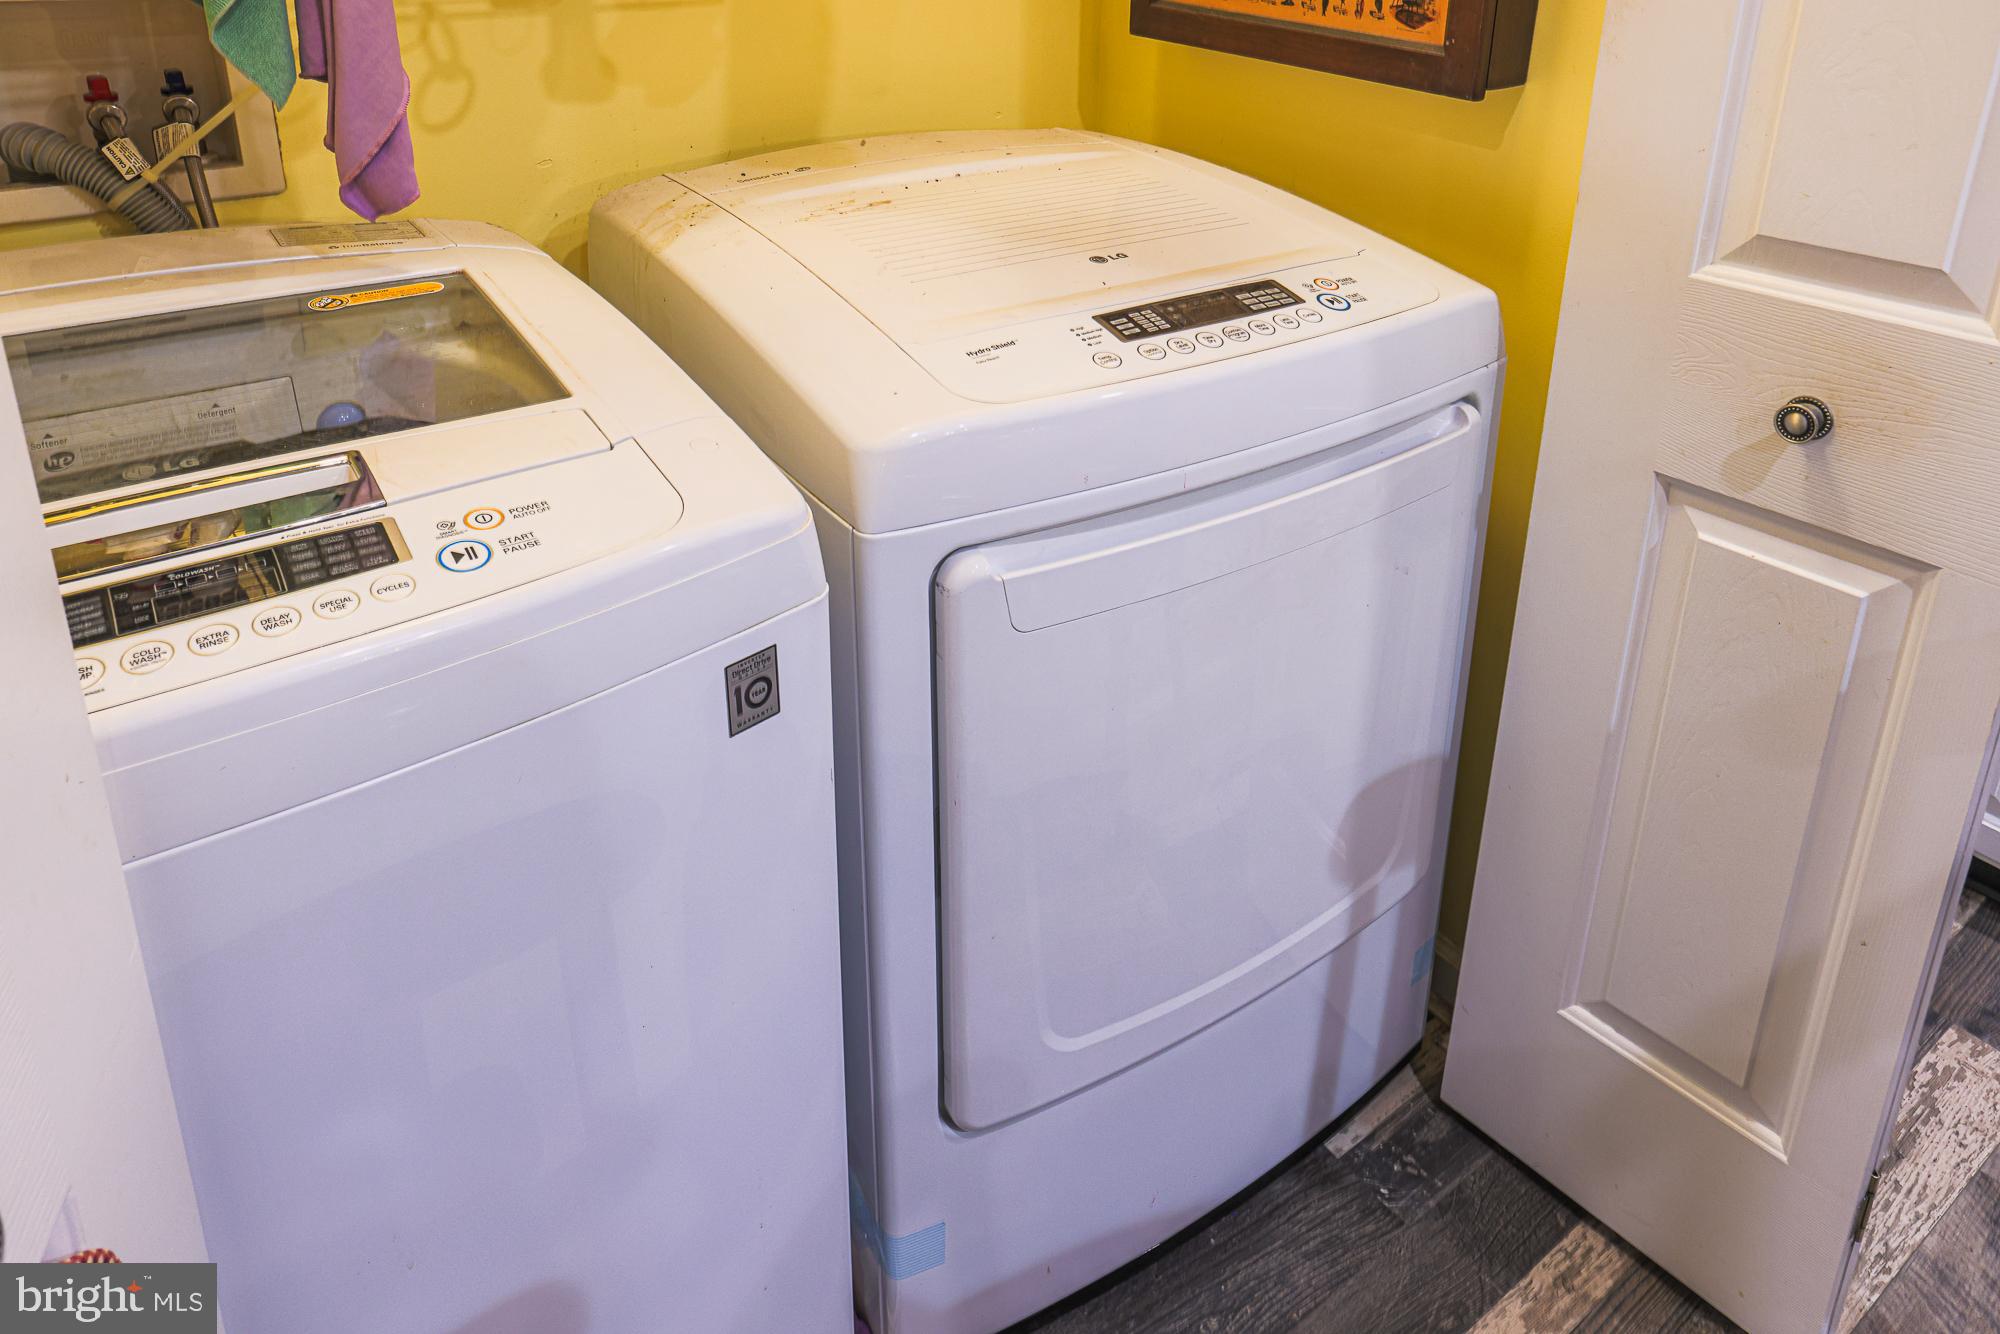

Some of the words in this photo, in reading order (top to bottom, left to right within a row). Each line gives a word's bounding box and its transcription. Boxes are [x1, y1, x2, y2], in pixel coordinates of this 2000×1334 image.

[105, 146, 127, 169] CAUTION
[1107, 253, 1129, 261] LG
[966, 347, 991, 359] Hydro
[991, 340, 1016, 350] Shield
[197, 407, 237, 420] Detergent
[30, 437, 69, 451] Softener
[163, 456, 201, 472] LG
[508, 500, 549, 514] POWER
[512, 510, 536, 520] AUTO
[536, 505, 552, 515] OFF
[498, 531, 536, 547] START
[502, 539, 542, 554] PAUSE
[376, 581, 410, 595] CYCLES
[319, 595, 354, 610] SPECIAL
[329, 603, 347, 613] USE
[260, 613, 290, 626] DELAY
[263, 618, 293, 632] WASH
[195, 630, 230, 645] EXTRA
[198, 636, 230, 650] RINSE
[132, 646, 161, 659] COLD
[78, 665, 93, 674] SH
[731, 664, 753, 679] Direct
[753, 655, 772, 669] Drive
[734, 676, 773, 717] 10
[751, 687, 767, 698] YEAR
[736, 706, 775, 729] WARRANTY
